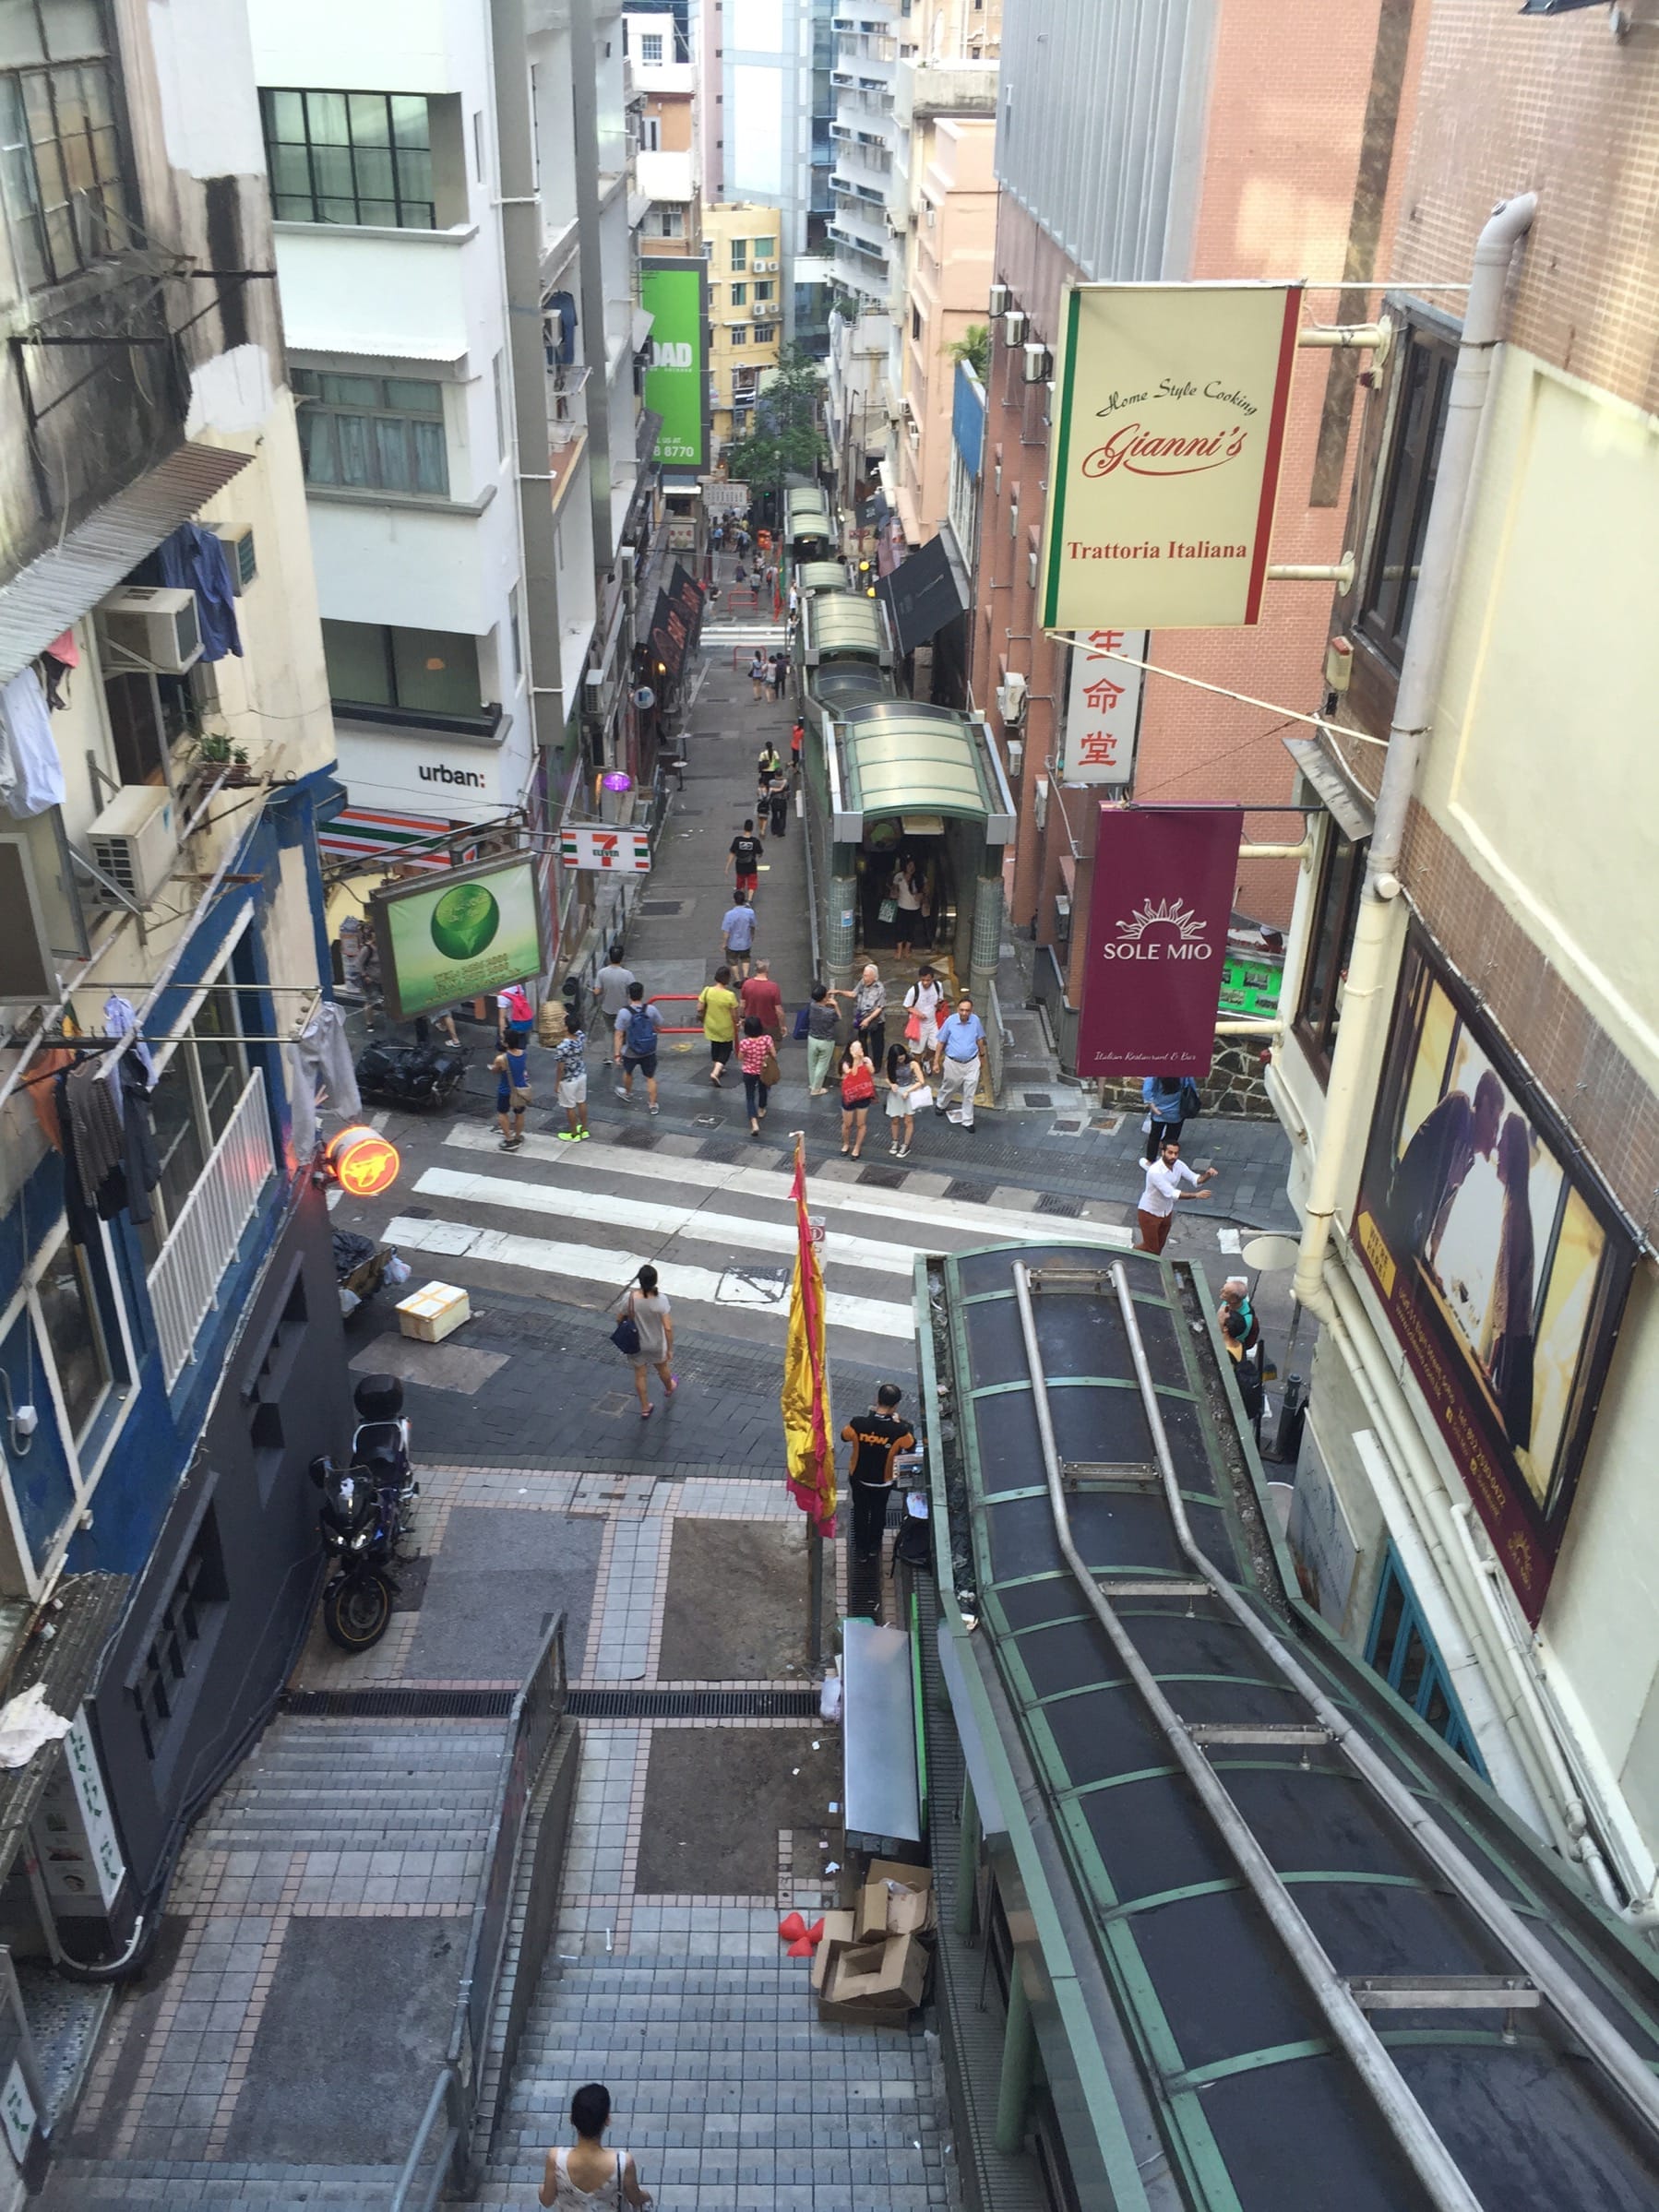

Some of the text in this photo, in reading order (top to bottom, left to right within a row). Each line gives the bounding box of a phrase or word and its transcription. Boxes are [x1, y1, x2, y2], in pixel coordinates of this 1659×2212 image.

[1096, 378, 1258, 417] Home Style Cooking
[663, 446, 694, 458] 8770
[1081, 423, 1247, 478] Gianni's
[1068, 541, 1247, 559] Trattoria Italiana
[1078, 630, 1128, 767] 生命堂
[591, 834, 618, 867] 7
[1104, 944, 1161, 959] SOLE
[1167, 944, 1211, 959] MIO
[1094, 1051, 1123, 1061] Italian
[1125, 1052, 1168, 1061] Restaurant
[1181, 1052, 1197, 1061] Bar
[1366, 1236, 1386, 1285] HERE!
[1368, 1223, 1389, 1271] WE'RE
